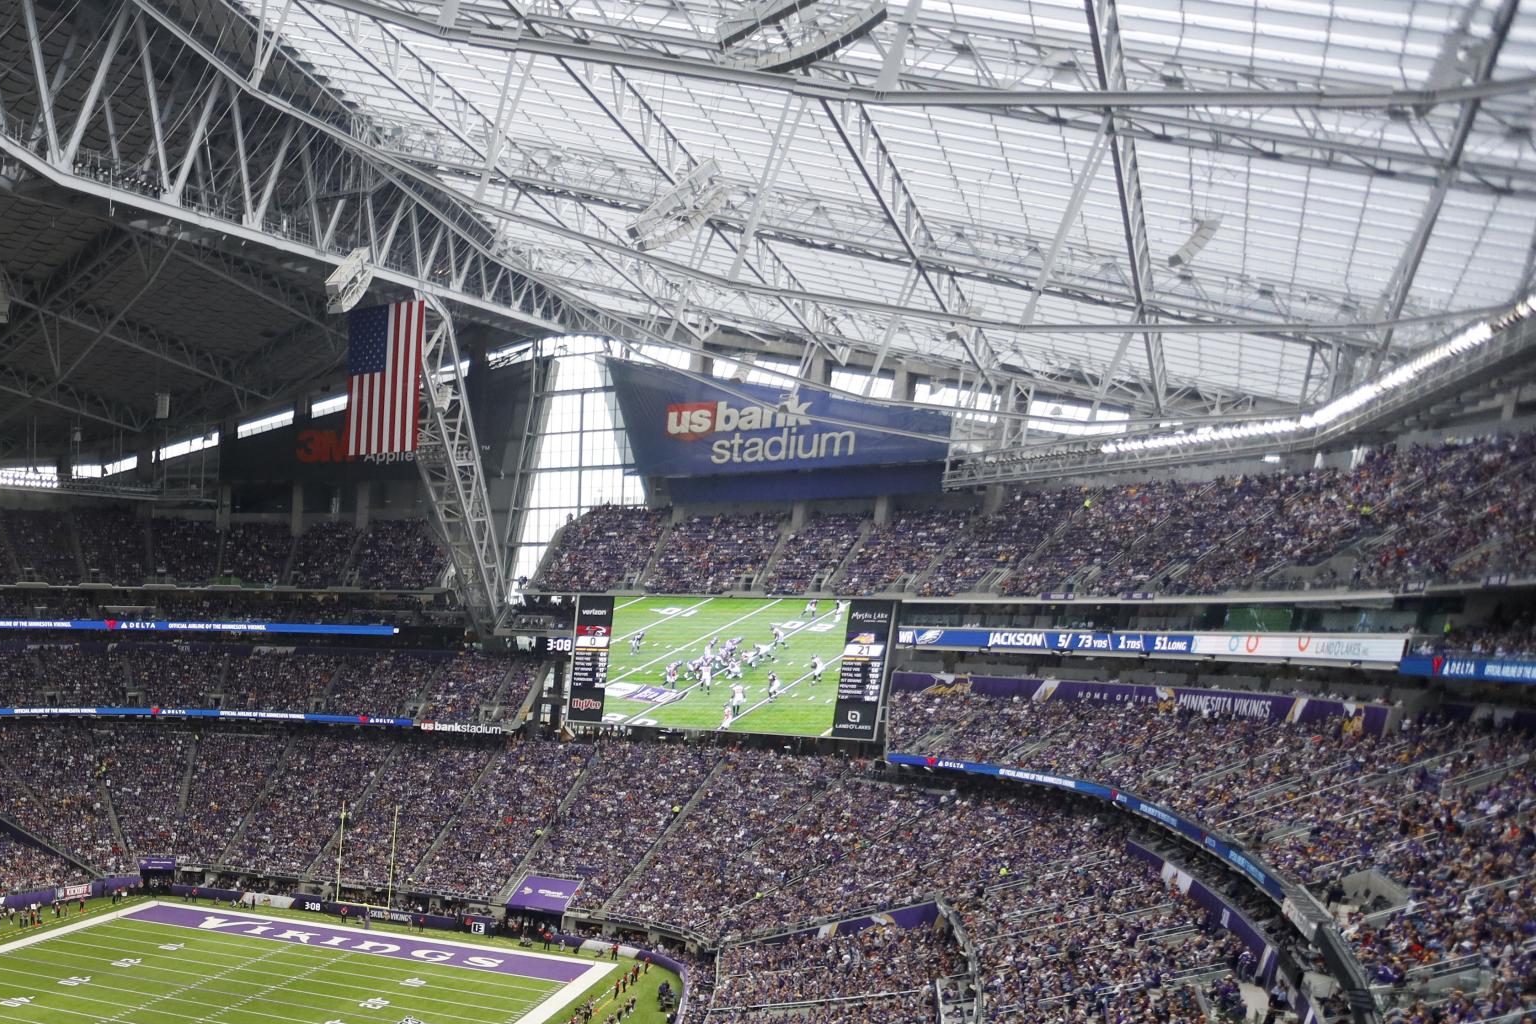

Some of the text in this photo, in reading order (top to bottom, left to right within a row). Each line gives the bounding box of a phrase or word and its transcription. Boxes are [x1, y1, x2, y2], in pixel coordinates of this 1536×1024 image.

[711, 426, 855, 464] stadium
[582, 608, 606, 616] verizon
[898, 630, 913, 643] WR
[987, 632, 1043, 647] JACKSON
[1078, 634, 1093, 648] 73
[1092, 639, 1108, 649] YDS
[1154, 636, 1187, 651] 51 LONG
[546, 638, 572, 651] 3:08
[857, 645, 870, 655] 21
[1450, 661, 1475, 675] DELTA
[1077, 690, 1109, 701] HOME
[1133, 695, 1153, 703] THE
[1179, 693, 1231, 715] MINNESOTA
[1233, 698, 1272, 718] VIKINGS
[305, 902, 321, 912] 3:08
[370, 910, 384, 920] SKOL
[197, 916, 505, 968] VIKINGS
